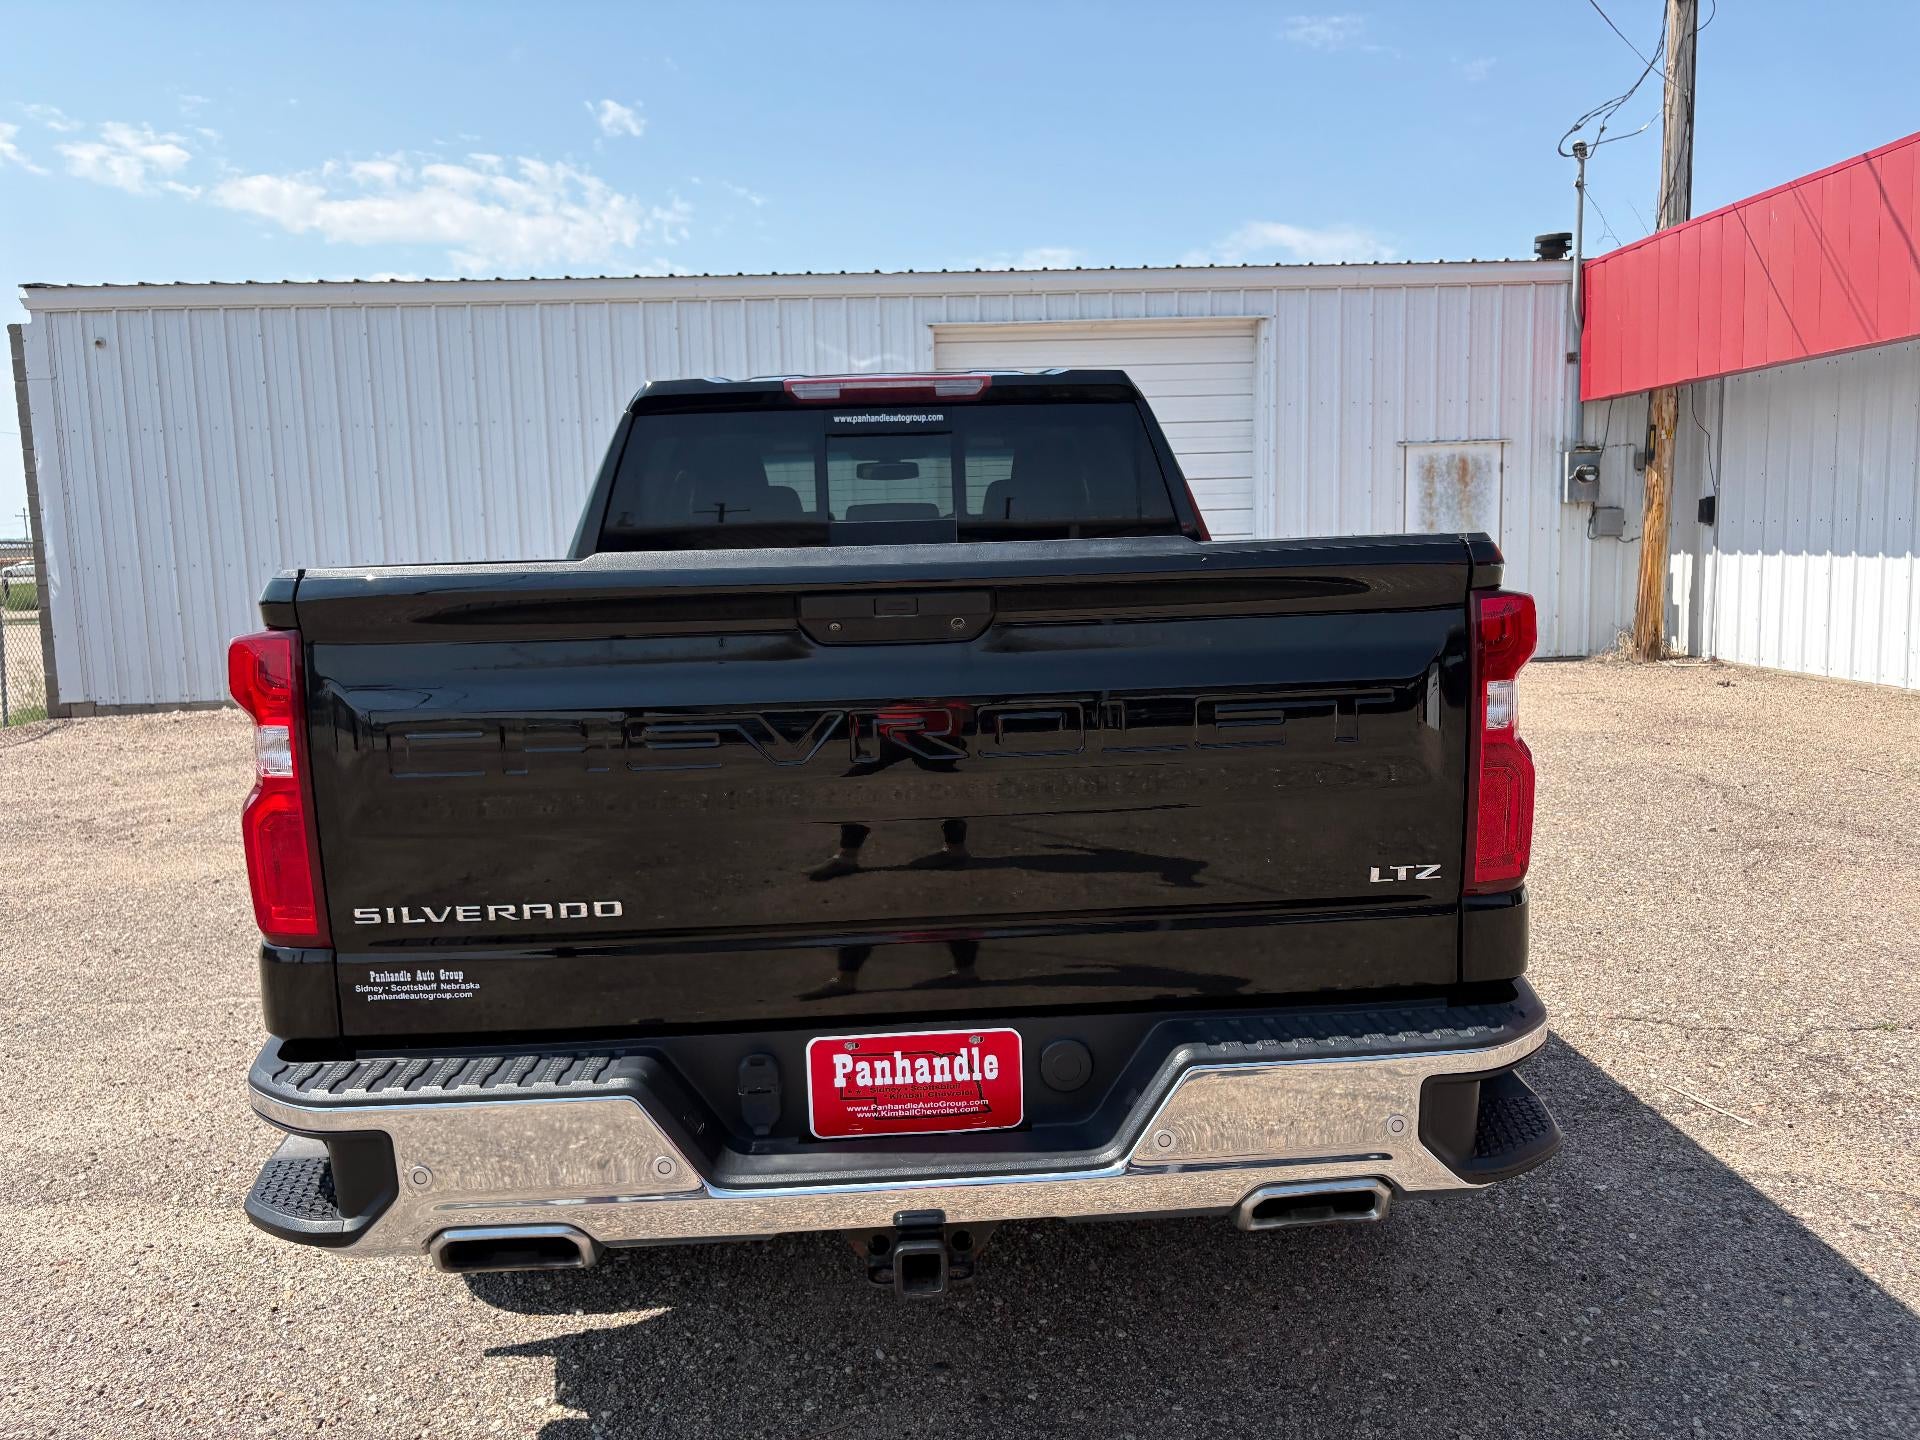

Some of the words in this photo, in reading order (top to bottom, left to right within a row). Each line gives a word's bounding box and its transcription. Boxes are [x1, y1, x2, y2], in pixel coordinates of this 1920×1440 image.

[833, 413, 944, 424] www.panhandleautogroup.com
[1370, 864, 1442, 882] LTZ
[353, 901, 623, 925] SILVERADO
[370, 970, 411, 983] Panhandle
[416, 970, 435, 981] Auto
[440, 969, 464, 982] Group
[355, 984, 383, 993] Sidney
[390, 983, 437, 992] Scottsbluff
[440, 982, 480, 990] Nebraska
[367, 991, 473, 1001] panhandleautogroup.com
[833, 1047, 999, 1088] Panhandle
[846, 1099, 989, 1112] www.PanhandleAutoGroup.com
[856, 1106, 979, 1118] www.KimballChevrolet.com
